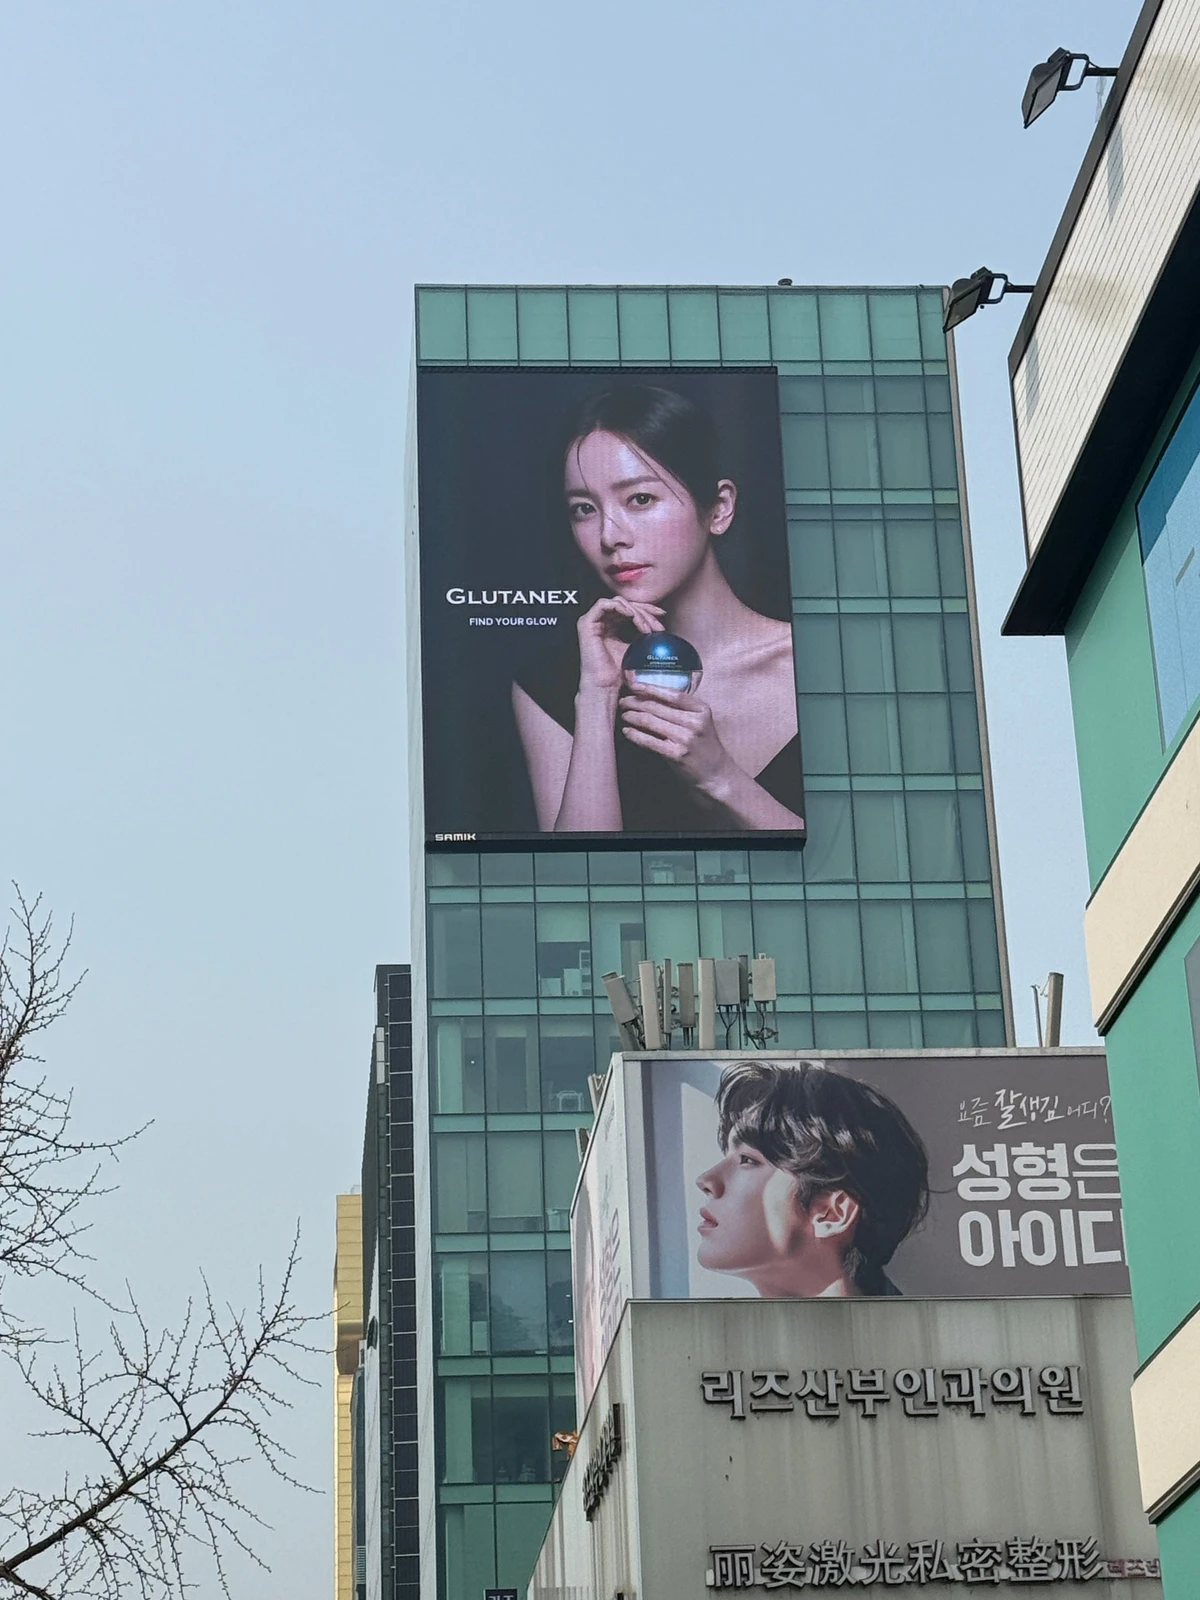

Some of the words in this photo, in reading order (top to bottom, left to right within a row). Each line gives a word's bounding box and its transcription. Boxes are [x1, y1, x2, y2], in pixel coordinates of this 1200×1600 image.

[446, 587, 579, 605] GLUTANEX
[469, 617, 493, 626] FIND
[495, 617, 524, 626] YOUR
[526, 617, 558, 626] GLOW
[957, 1096, 992, 1127] 요즘
[994, 1088, 1065, 1131] 잘생김
[1066, 1095, 1111, 1124] 어디?
[700, 1365, 1085, 1419] 리즈산부인과의원
[707, 1535, 1106, 1590] 丽姿激光私密整形
